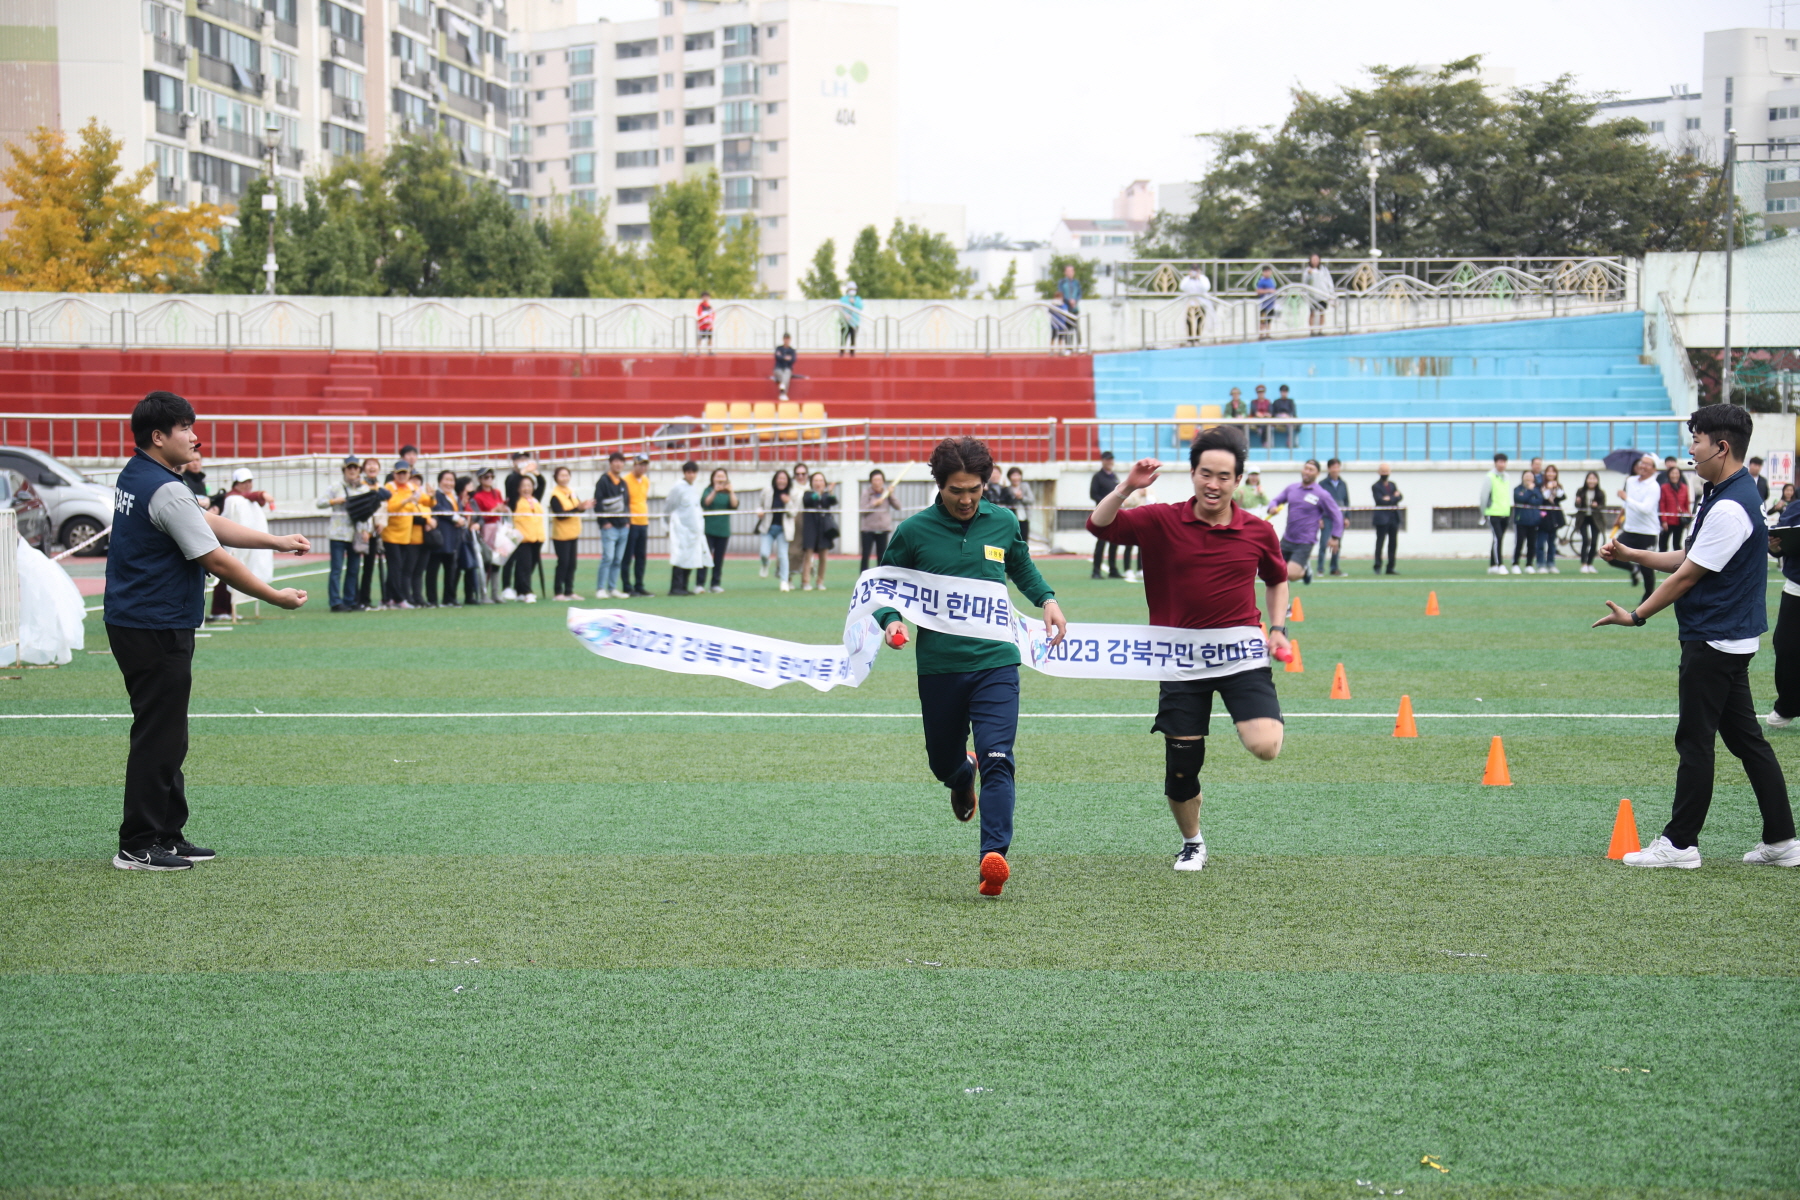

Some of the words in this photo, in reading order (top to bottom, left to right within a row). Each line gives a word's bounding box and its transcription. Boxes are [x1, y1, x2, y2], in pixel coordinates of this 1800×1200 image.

[821, 80, 848, 97] LH
[836, 108, 856, 126] 404
[115, 487, 136, 516] TAFF
[861, 578, 939, 616] 강북구민
[946, 591, 1009, 627] 한마음
[680, 636, 771, 673] 강북구민
[1046, 637, 1100, 662] 2023
[1107, 638, 1195, 668] 강북구민
[1200, 638, 1265, 668] 한마음
